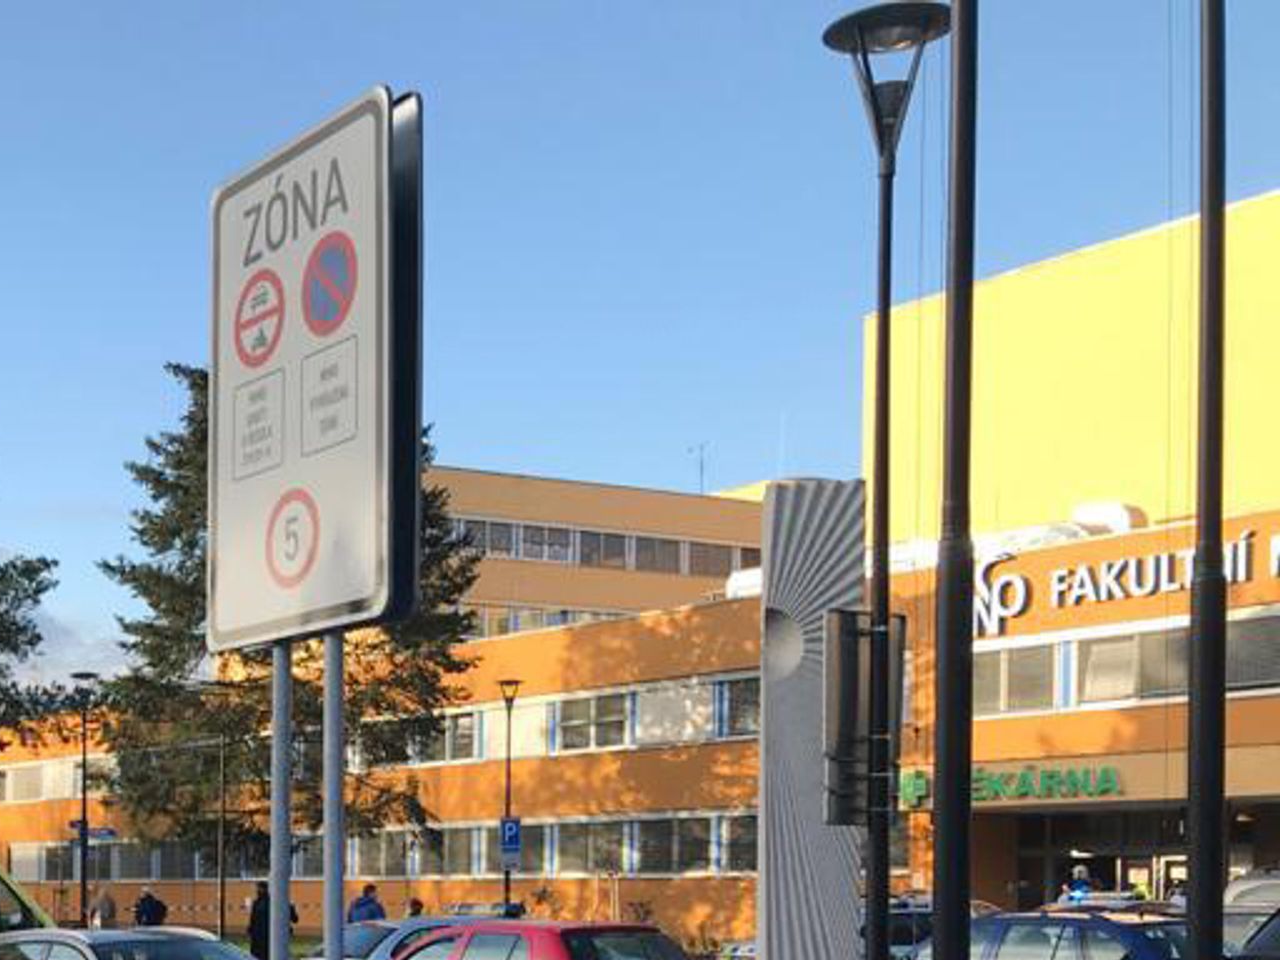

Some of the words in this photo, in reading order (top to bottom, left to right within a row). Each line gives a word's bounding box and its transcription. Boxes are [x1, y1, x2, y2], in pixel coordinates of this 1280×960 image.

[243, 157, 349, 267] ZÓNA
[284, 515, 299, 561] 5
[971, 763, 1123, 801] ÉKÁRNA
[504, 821, 517, 842] P
